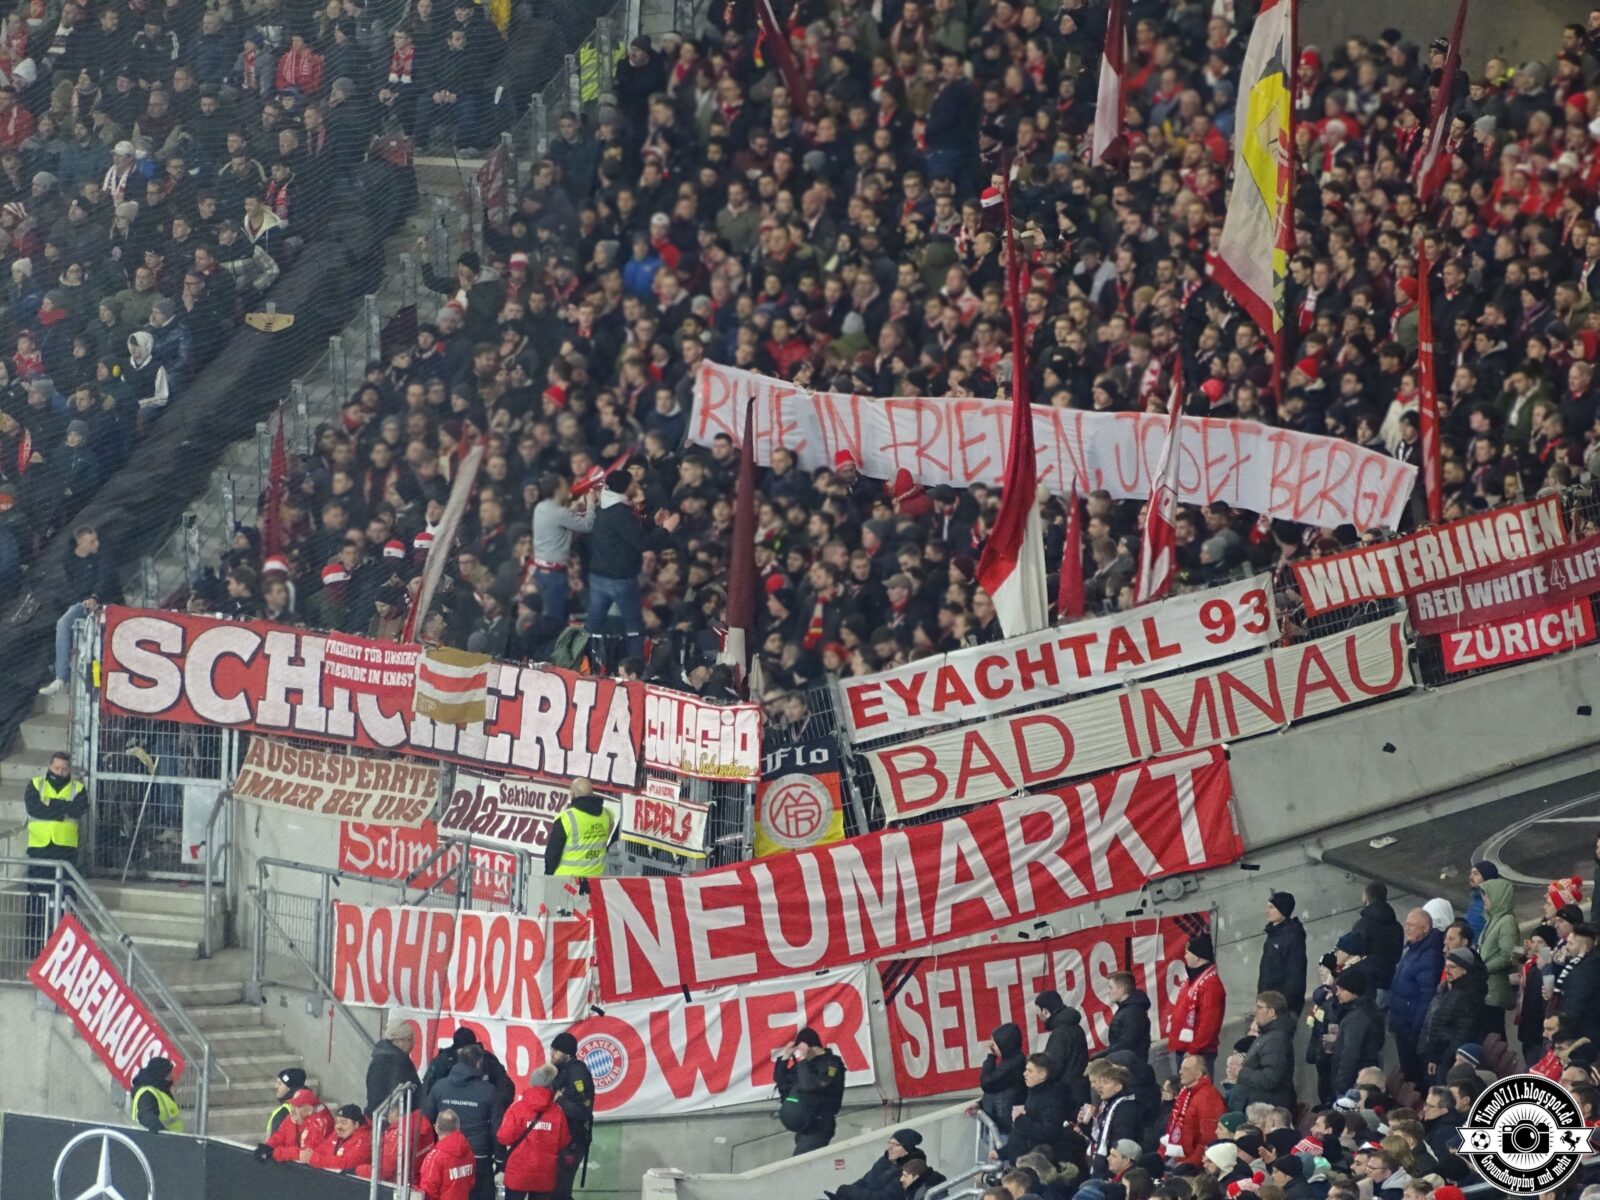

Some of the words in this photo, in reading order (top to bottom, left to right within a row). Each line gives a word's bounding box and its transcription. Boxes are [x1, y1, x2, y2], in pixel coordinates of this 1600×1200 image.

[1298, 500, 1566, 611] WINTERLINGEN
[1416, 586, 1463, 621] RED
[1464, 564, 1549, 610] WHITE
[846, 616, 1181, 730] EYACHTAL
[1199, 588, 1272, 644] 93
[1450, 603, 1586, 667] ZÜRICH
[877, 713, 1075, 815] BAD
[1119, 623, 1402, 760] IMNAU
[234, 768, 324, 812] IMMER
[321, 787, 374, 818] BEI
[371, 794, 428, 823] UNS
[245, 737, 441, 799] AUSGESPERRTE
[499, 782, 547, 810] Sektion
[633, 797, 693, 844] REBELS
[600, 749, 1215, 997] NEUMARKT
[332, 902, 592, 1021] ROHRDORF
[894, 940, 1120, 1080] SELTERS
